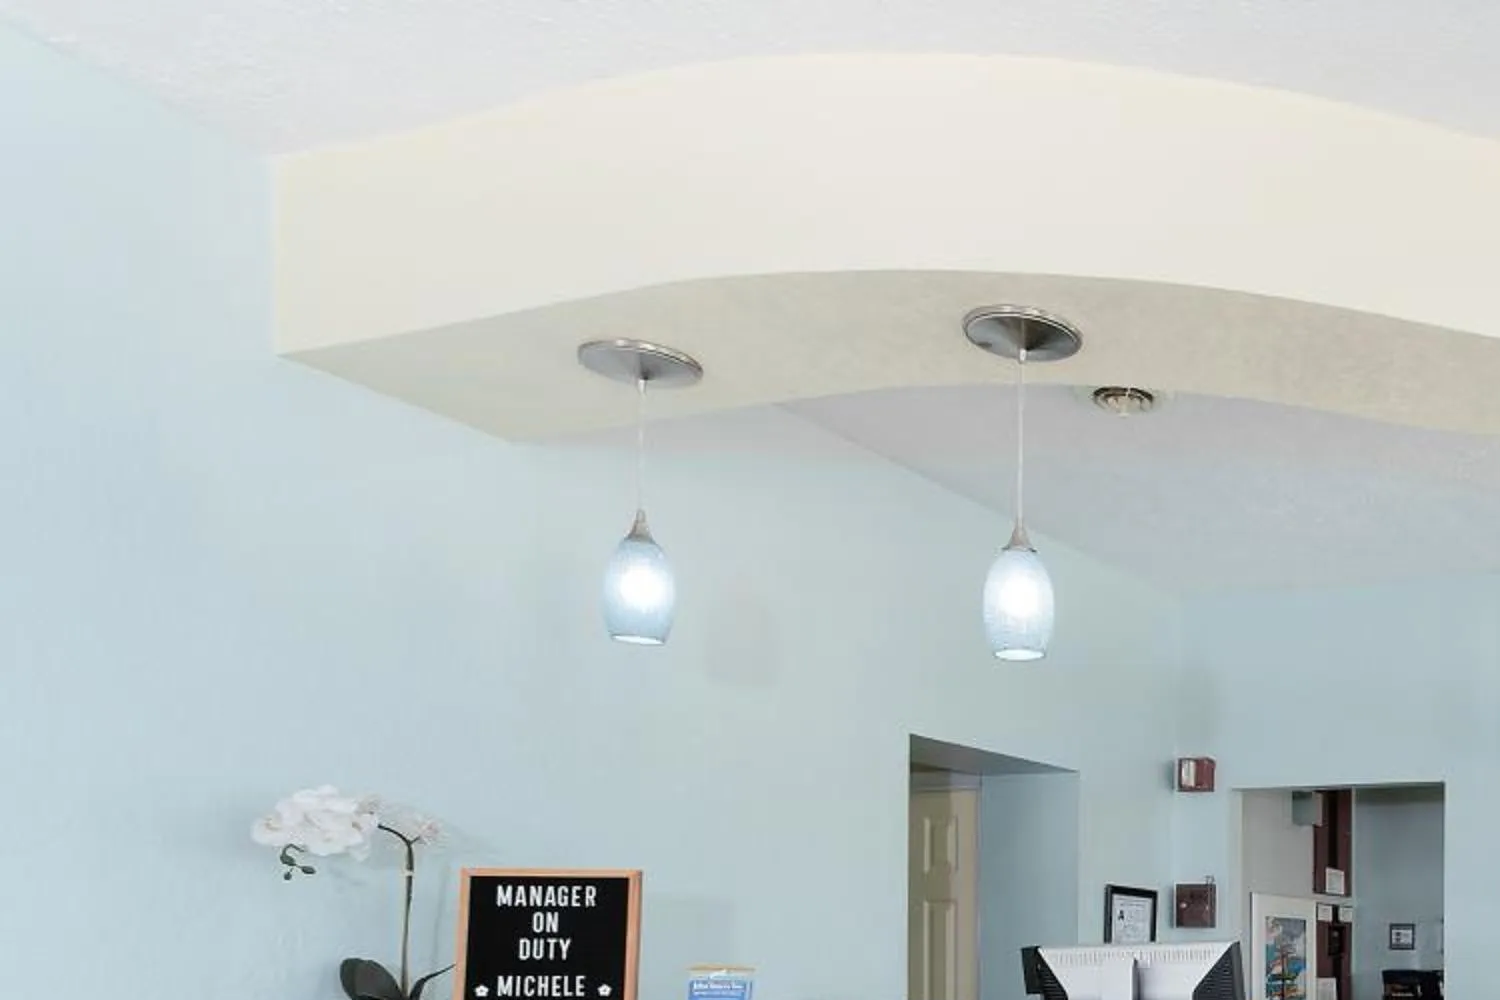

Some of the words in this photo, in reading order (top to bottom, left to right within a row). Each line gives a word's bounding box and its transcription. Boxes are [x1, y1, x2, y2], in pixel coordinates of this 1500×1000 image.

[496, 885, 597, 908] MANAGER
[532, 912, 559, 934] ON
[518, 938, 571, 961] DUTY
[497, 976, 586, 997] MICHELE
